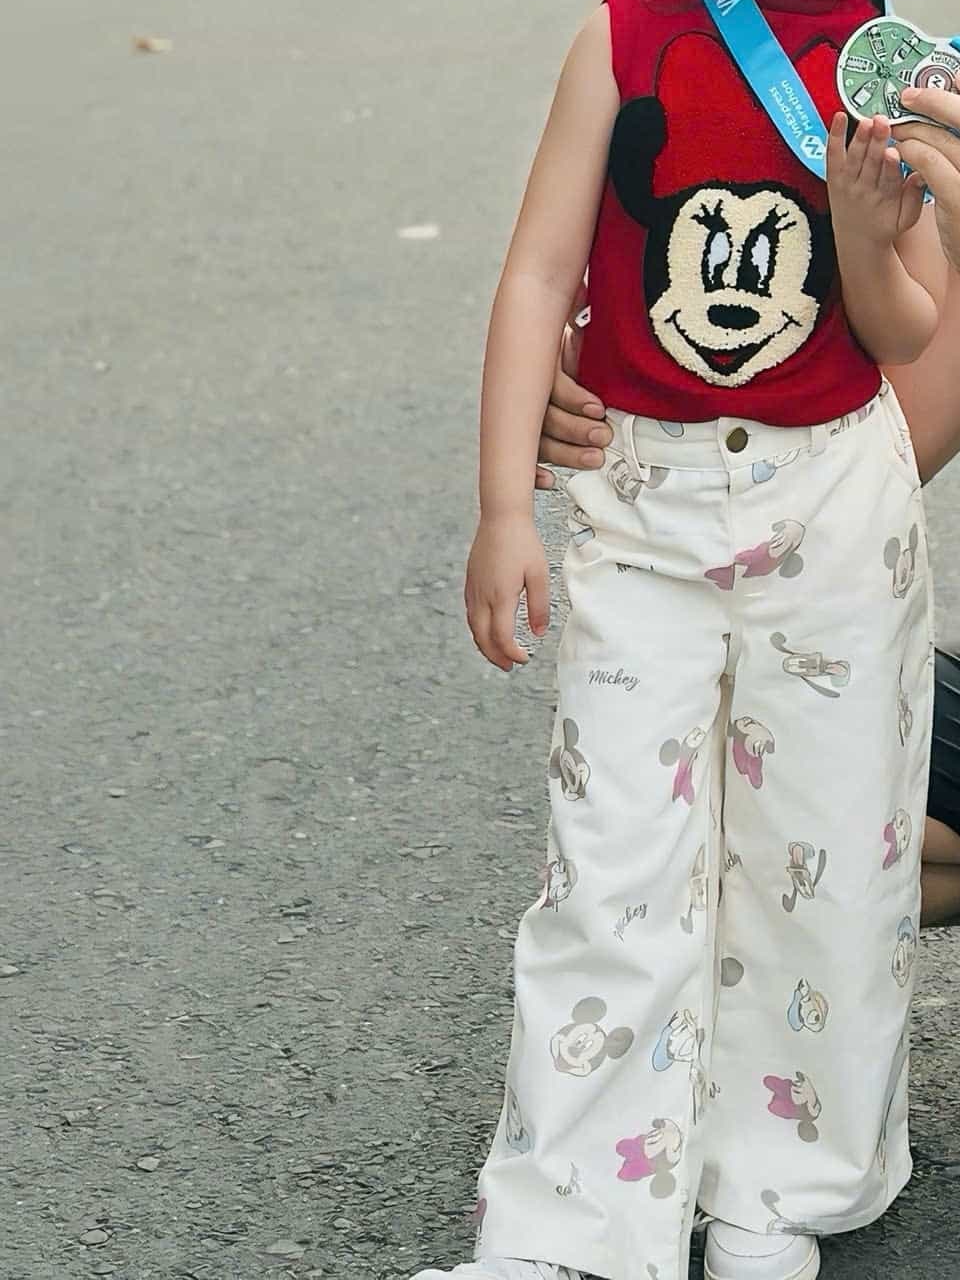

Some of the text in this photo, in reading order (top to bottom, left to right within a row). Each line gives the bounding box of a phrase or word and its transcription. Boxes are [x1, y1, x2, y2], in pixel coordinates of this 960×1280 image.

[768, 86, 803, 138] VnExpress
[781, 79, 814, 131] Marathon
[588, 668, 641, 692] Mickey
